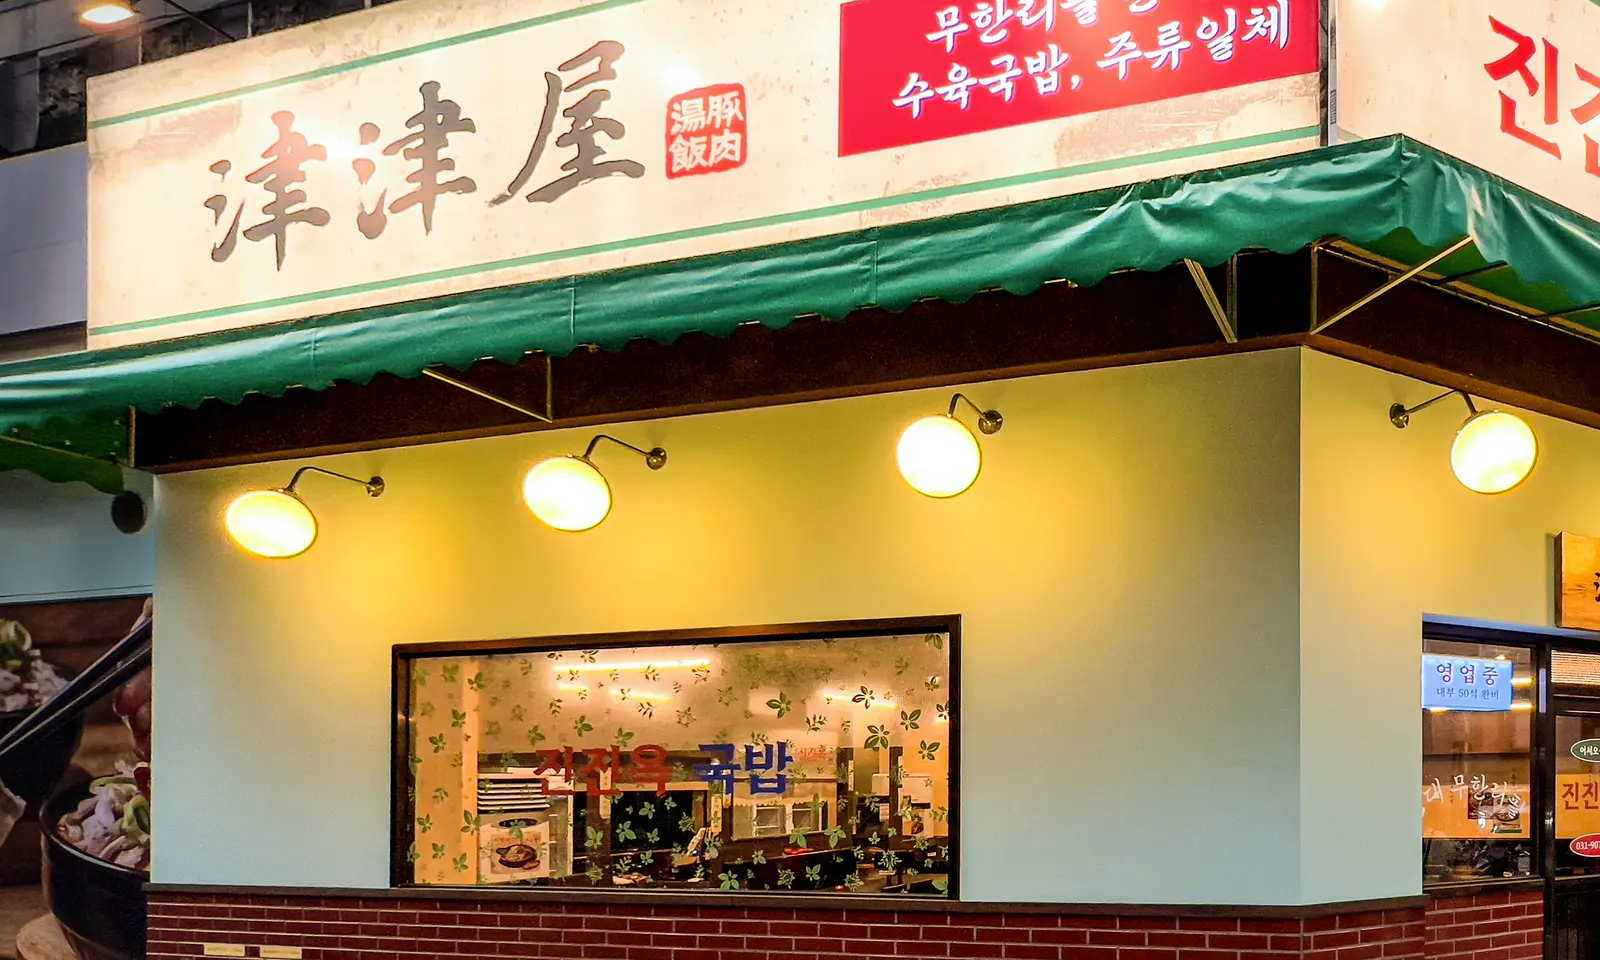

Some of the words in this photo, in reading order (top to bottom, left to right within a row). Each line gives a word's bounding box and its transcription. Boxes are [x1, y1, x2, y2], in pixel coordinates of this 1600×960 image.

[1436, 663, 1499, 686] 영업중
[1579, 745, 1600, 756] 어서오
[533, 744, 676, 799] 진진옥
[692, 740, 794, 796] 국밥
